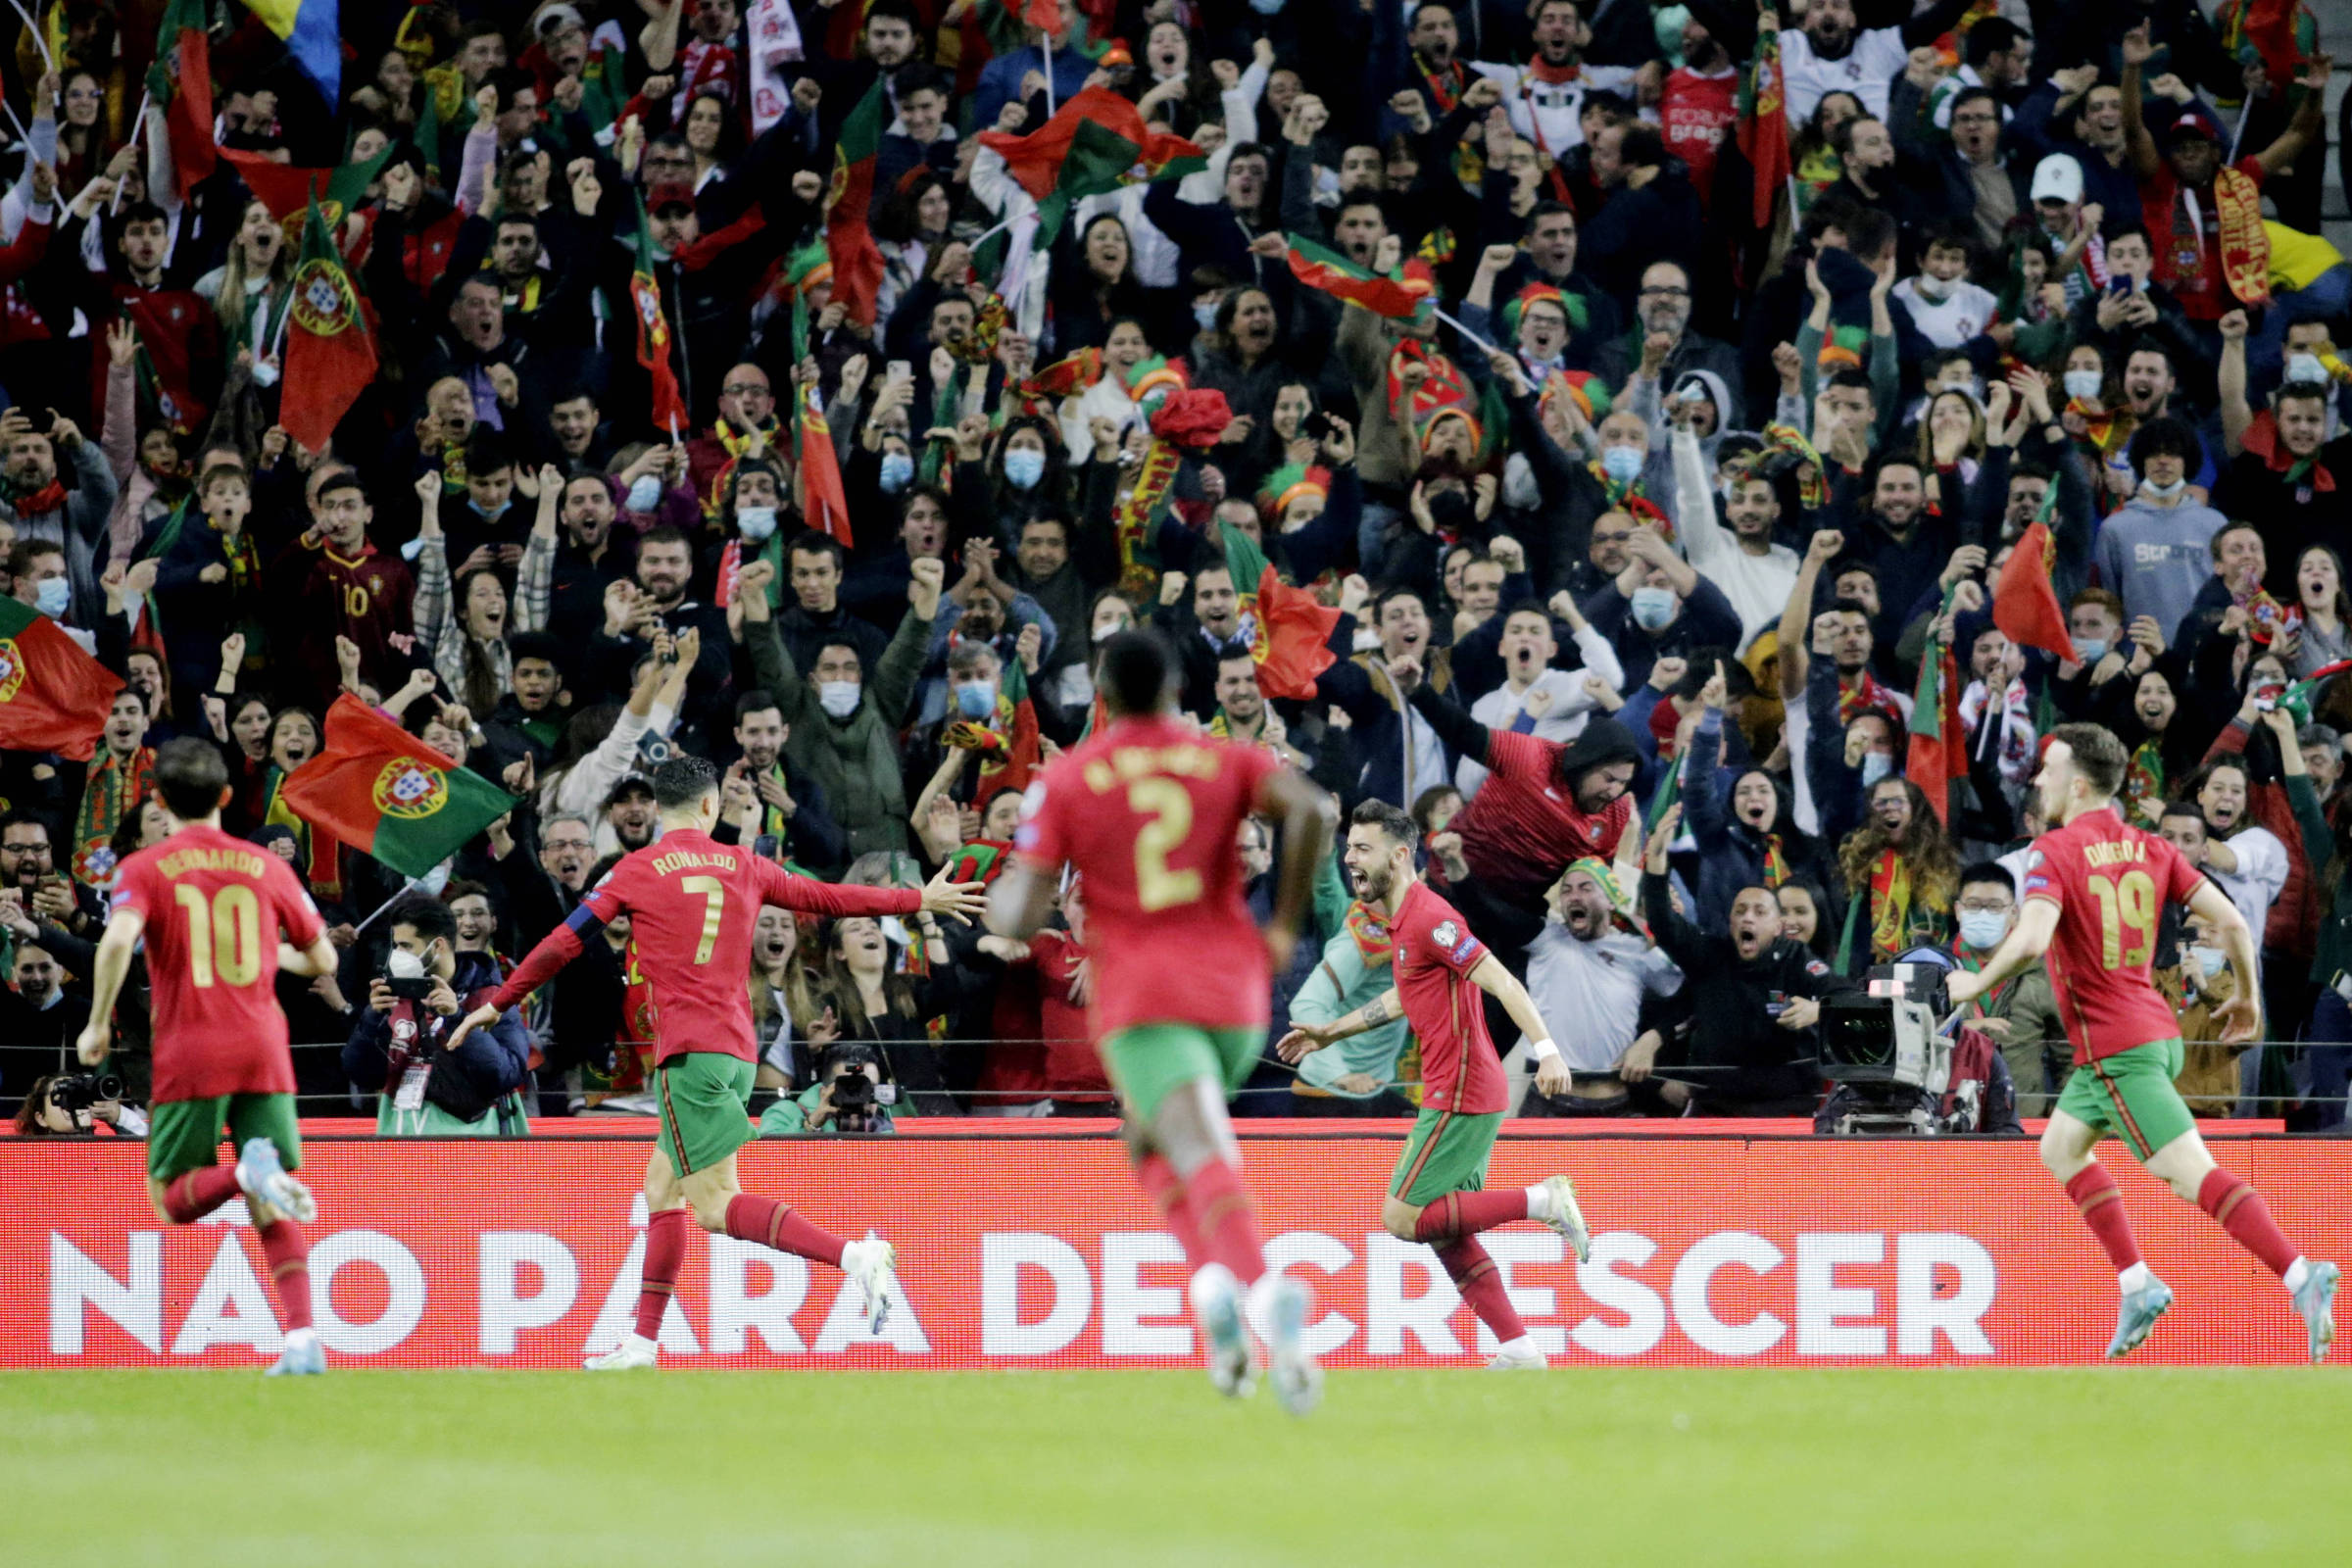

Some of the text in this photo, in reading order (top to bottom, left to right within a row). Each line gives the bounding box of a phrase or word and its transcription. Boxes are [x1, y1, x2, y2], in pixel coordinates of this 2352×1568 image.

[344, 583, 368, 616] 10
[156, 848, 266, 880] BERNARDO
[652, 851, 738, 877] RONALDO
[1129, 776, 1203, 913] 2
[174, 883, 262, 988] 10
[681, 875, 724, 965] 7
[2088, 869, 2155, 971] 19
[981, 1230, 1194, 1355] DE
[1249, 1230, 1997, 1355] CRESCER
